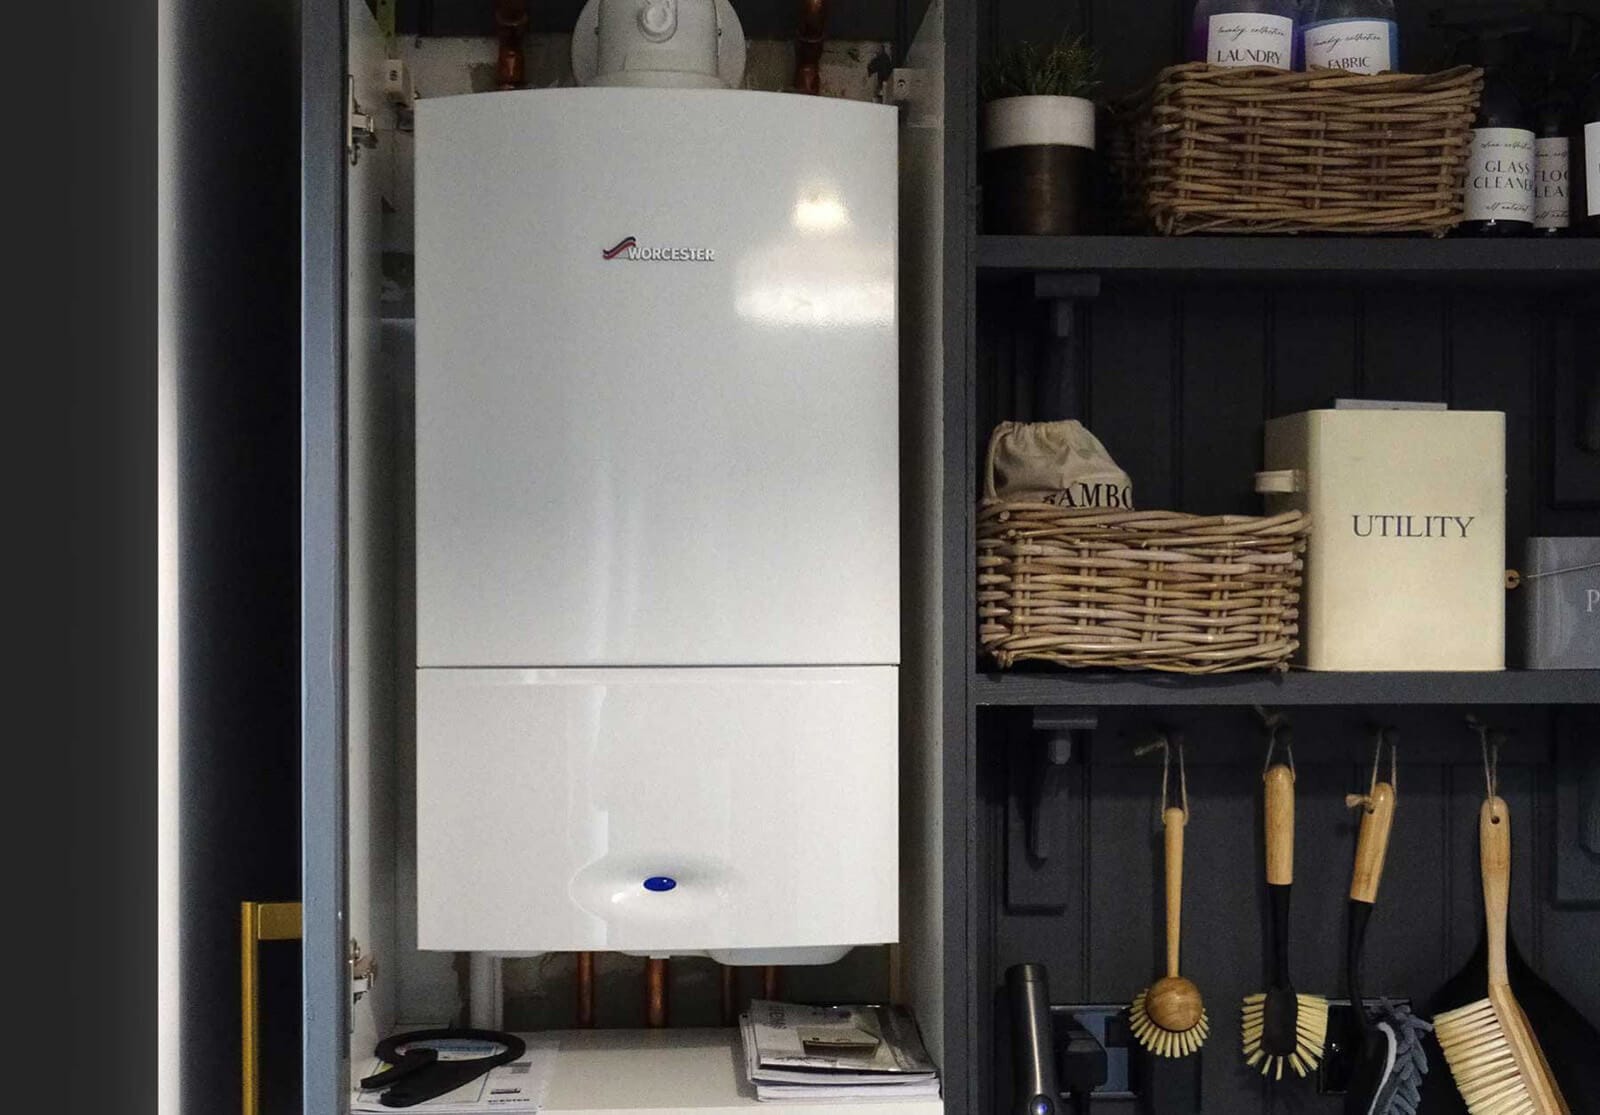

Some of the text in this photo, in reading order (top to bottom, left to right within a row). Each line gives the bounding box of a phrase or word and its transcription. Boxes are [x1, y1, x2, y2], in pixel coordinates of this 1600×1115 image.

[1217, 48, 1281, 65] LAUNDRY
[1327, 56, 1371, 71] FABRIC
[1484, 160, 1530, 176] GLASS
[1473, 176, 1534, 192] CLEANE
[627, 246, 715, 261] WORCESTER
[1352, 514, 1475, 538] UTILITY
